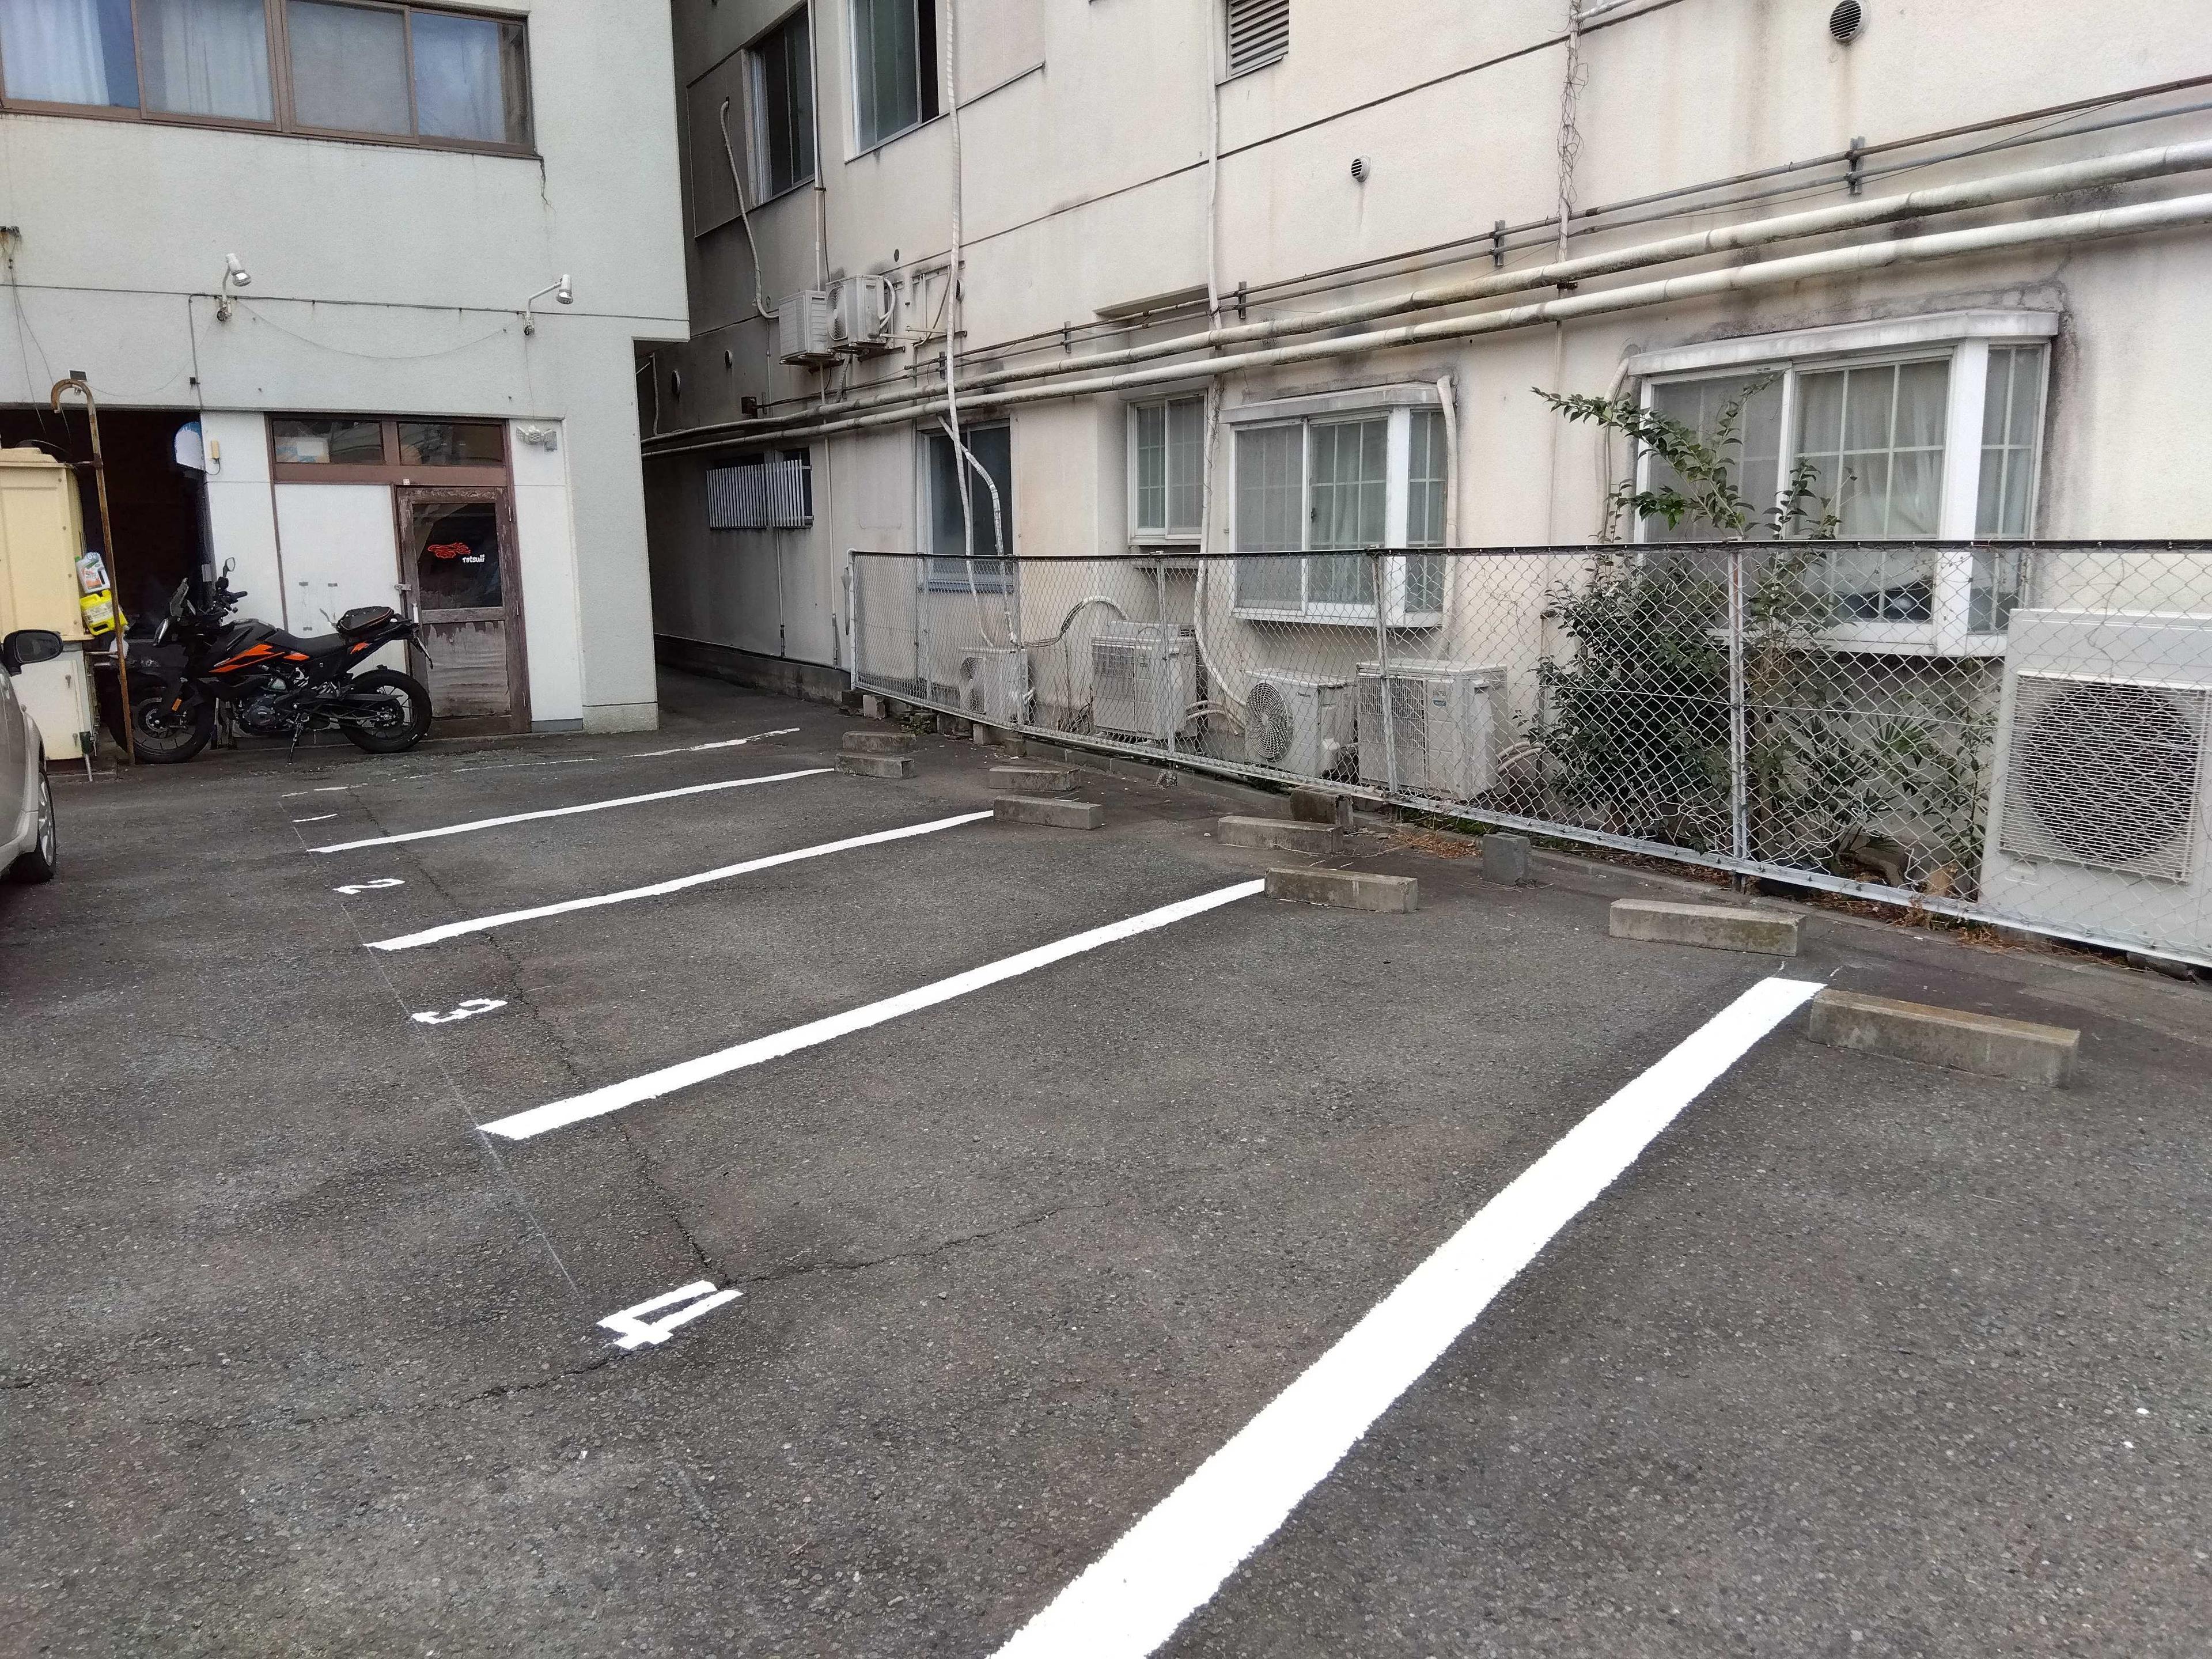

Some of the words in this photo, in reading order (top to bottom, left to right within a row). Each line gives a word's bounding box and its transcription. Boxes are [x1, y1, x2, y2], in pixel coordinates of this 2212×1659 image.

[332, 878, 406, 896] 2
[410, 998, 508, 1025] 3
[596, 1279, 744, 1350] 4
